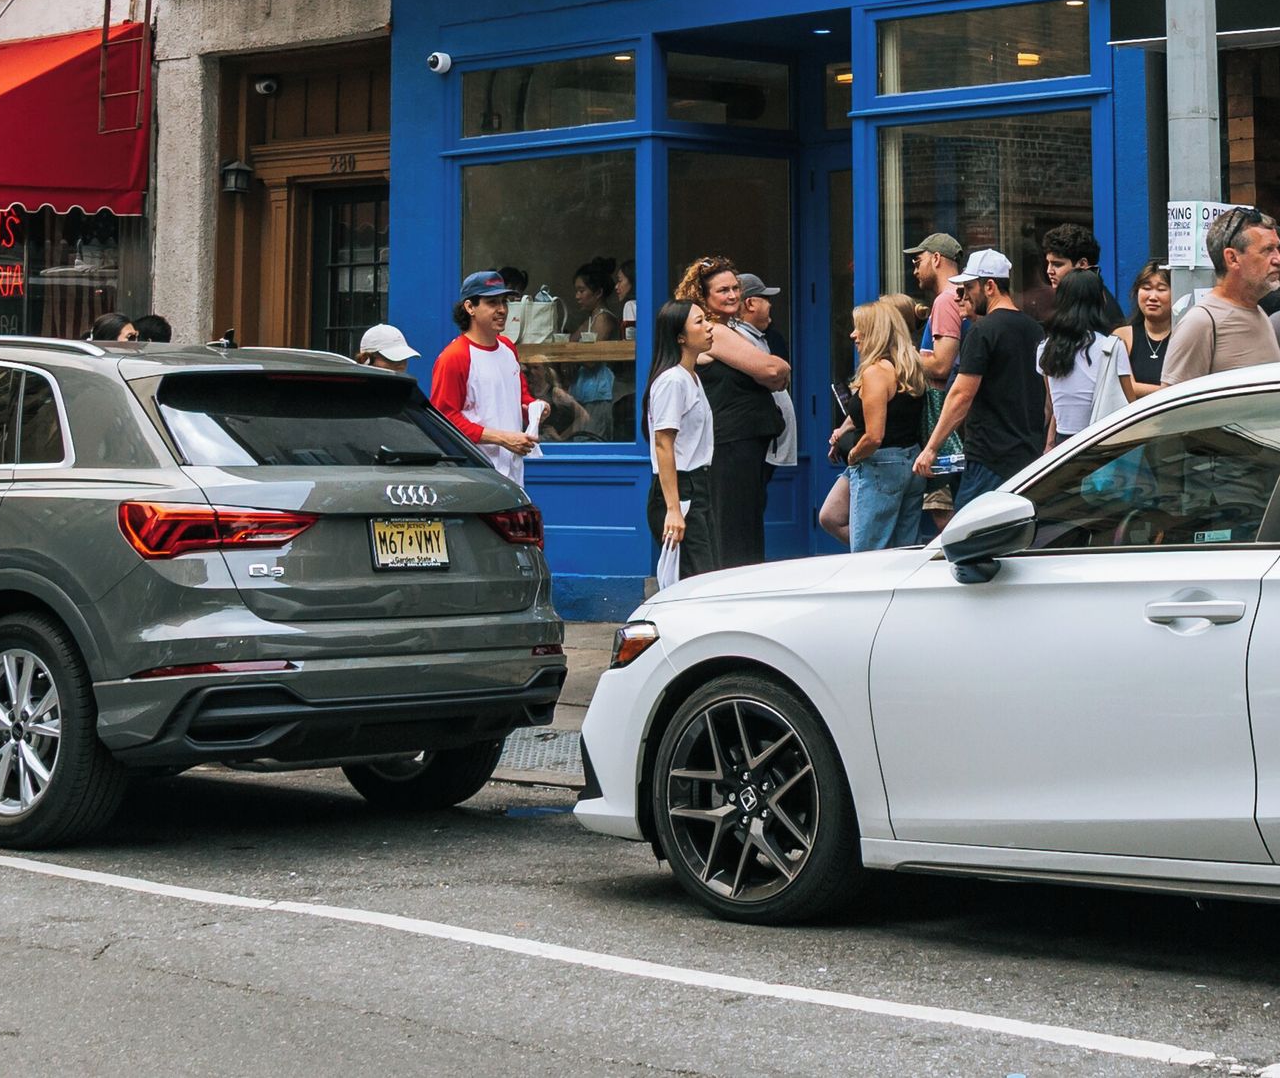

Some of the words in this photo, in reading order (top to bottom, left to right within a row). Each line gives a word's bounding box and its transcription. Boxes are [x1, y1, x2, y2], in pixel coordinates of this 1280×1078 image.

[378, 530, 405, 554] M67
[414, 530, 441, 553] VMY
[248, 564, 285, 578] Q3
